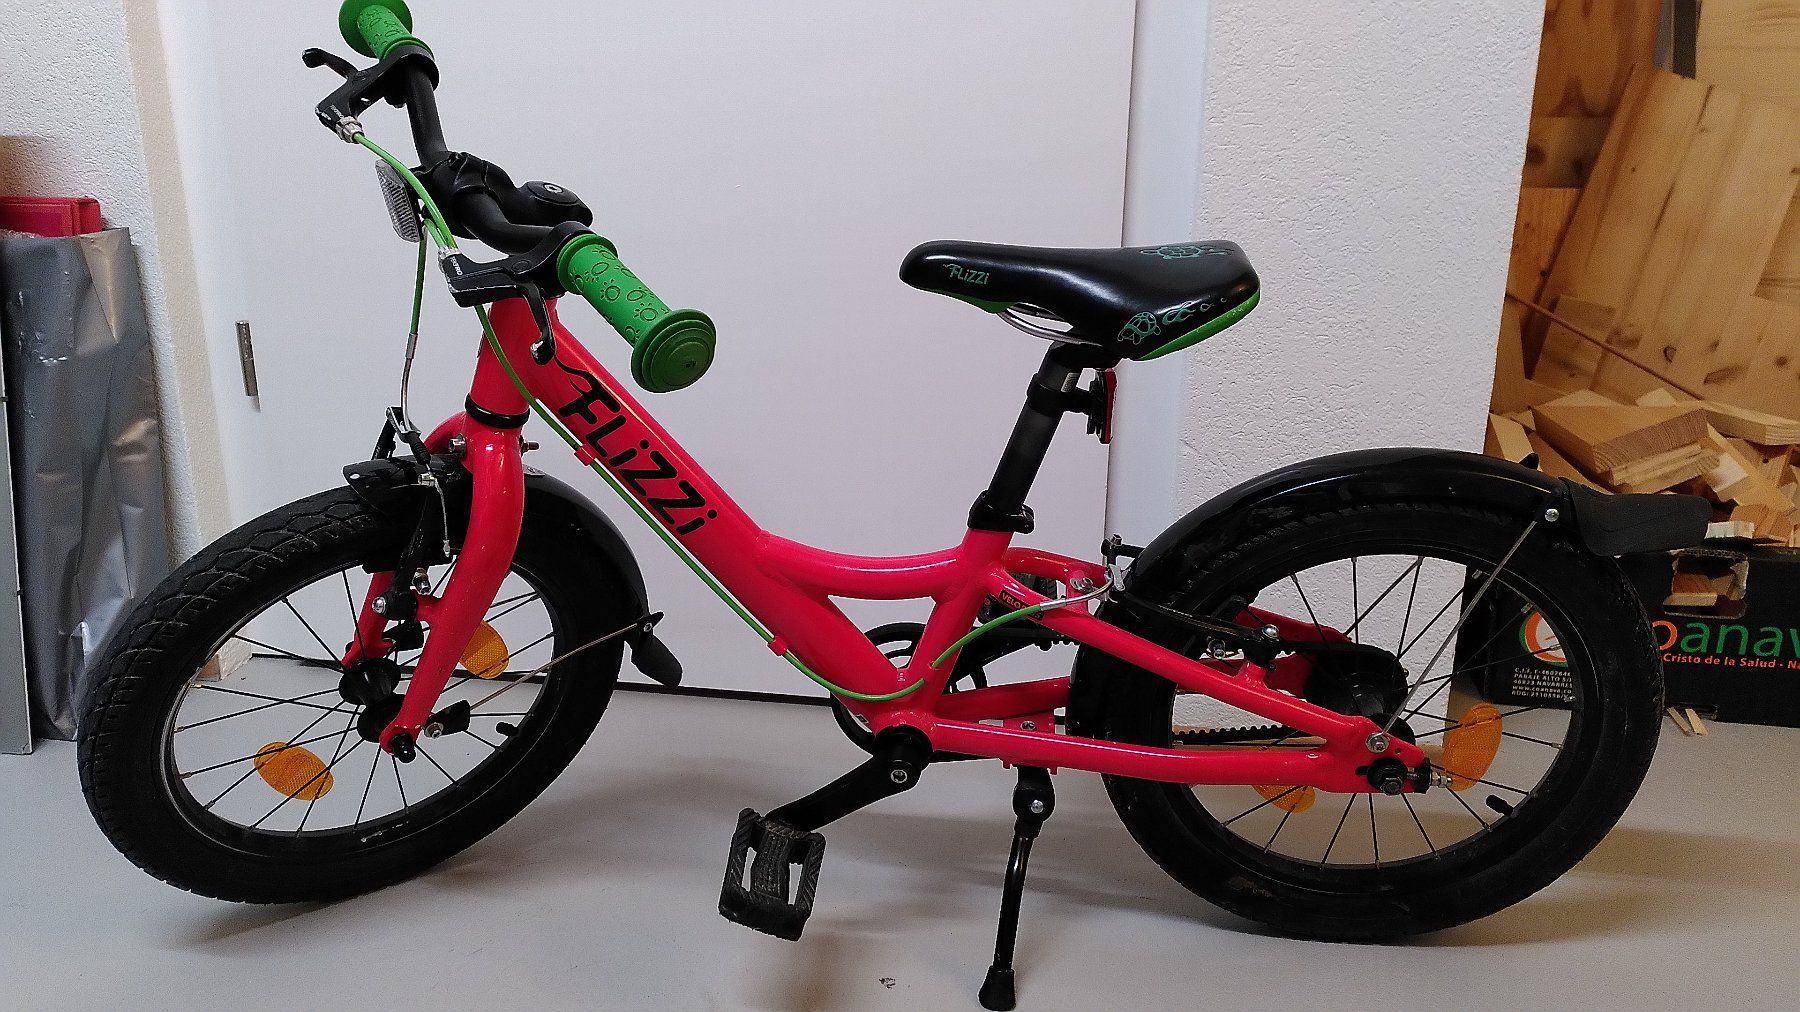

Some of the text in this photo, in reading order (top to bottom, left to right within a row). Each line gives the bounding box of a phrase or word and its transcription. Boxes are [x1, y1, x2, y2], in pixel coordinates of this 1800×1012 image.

[1663, 653, 1701, 665] Cristo
[1704, 655, 1721, 666] de
[1724, 656, 1735, 667] la
[1740, 658, 1777, 669] Salud
